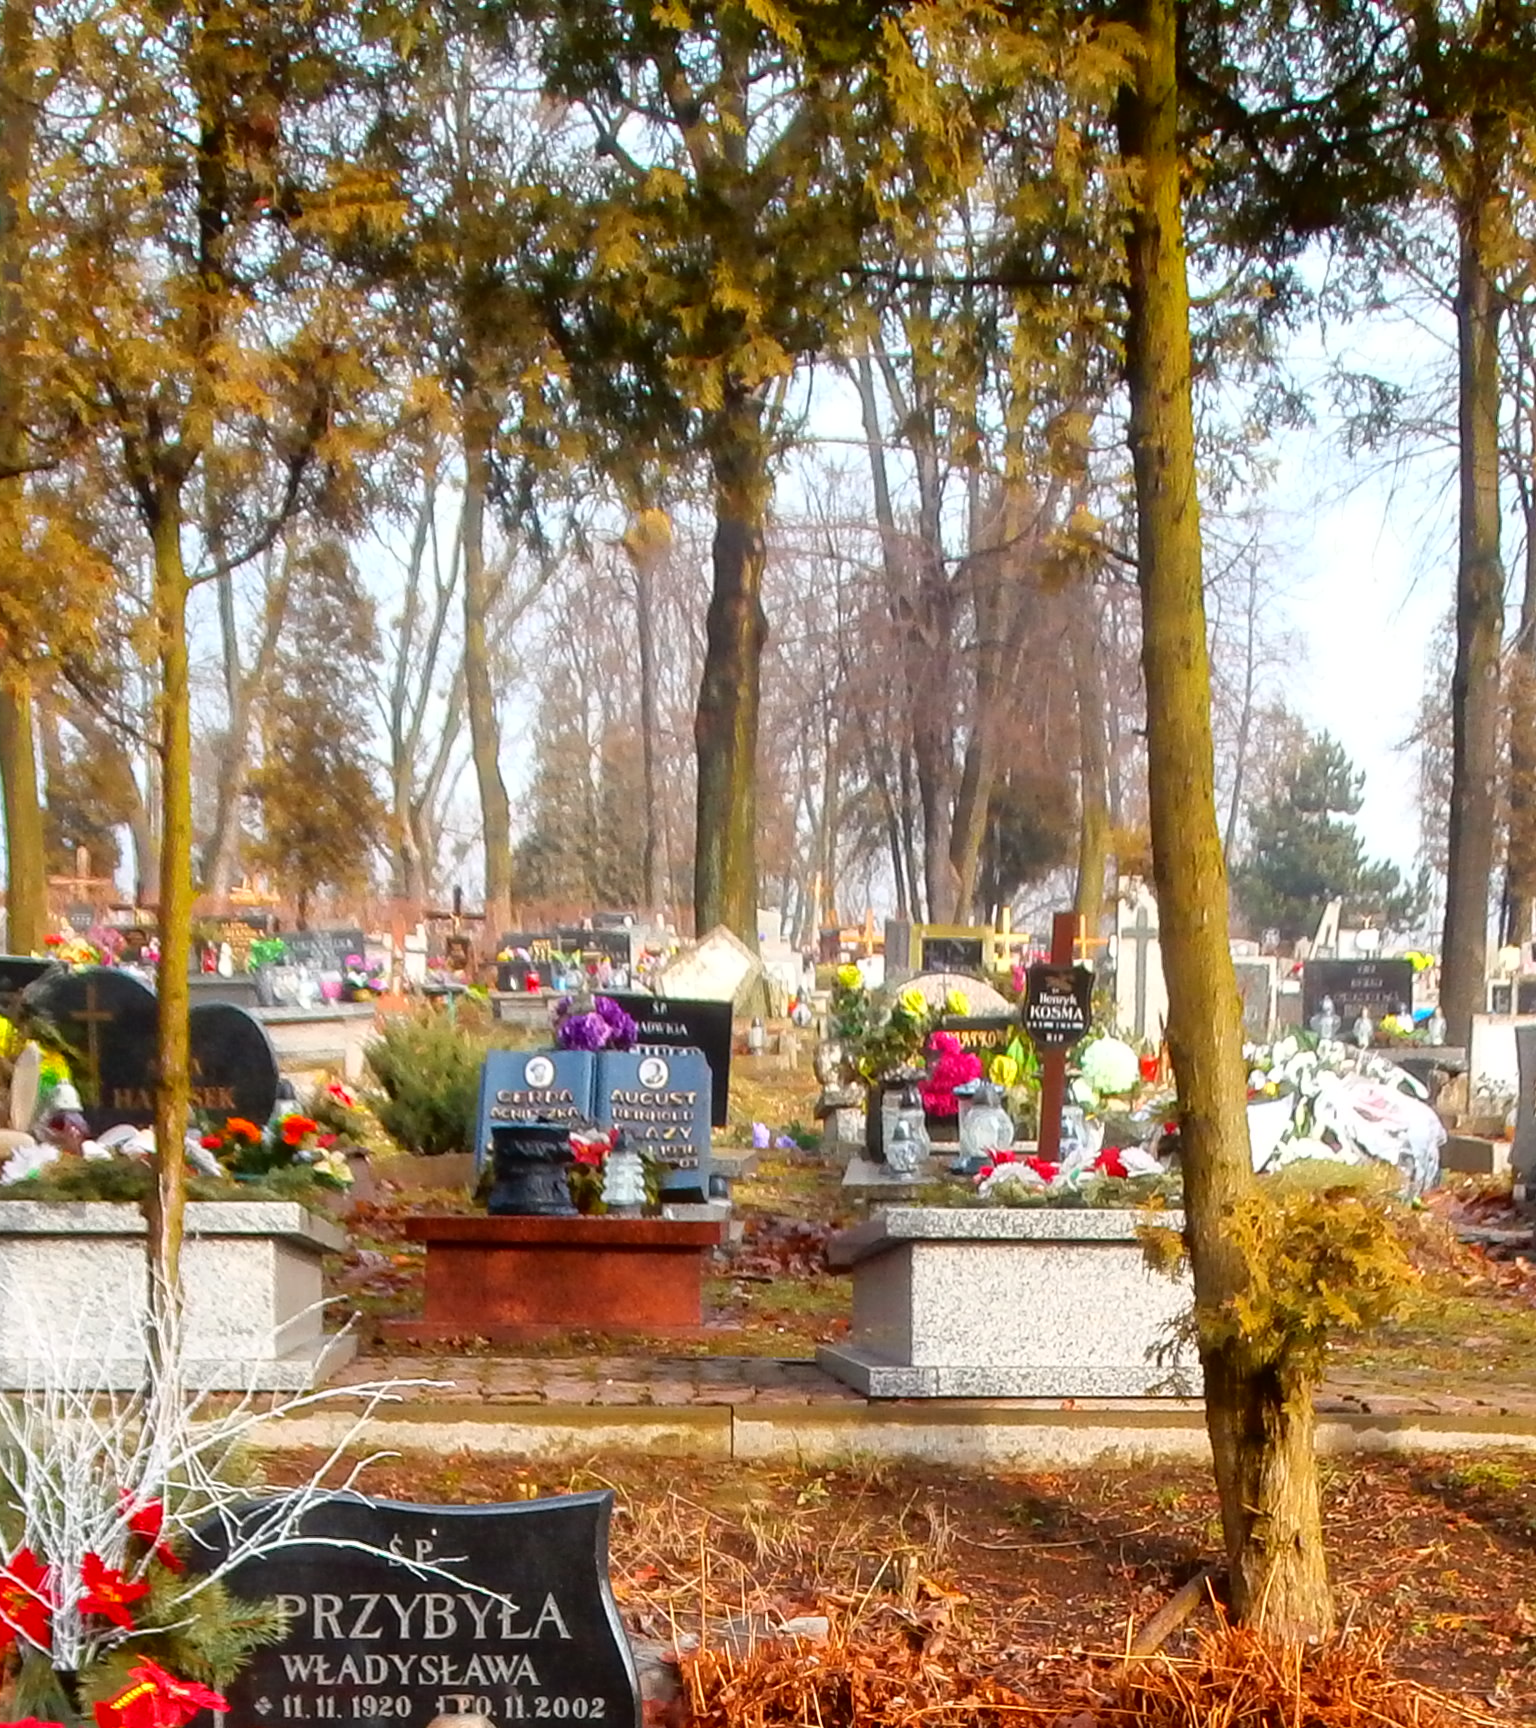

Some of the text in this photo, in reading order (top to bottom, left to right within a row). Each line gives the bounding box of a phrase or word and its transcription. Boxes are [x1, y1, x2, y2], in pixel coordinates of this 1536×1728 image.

[1039, 992, 1077, 1006] Henryk
[1030, 1005, 1083, 1021] KOSMA
[114, 1087, 237, 1109] HASEK
[275, 1592, 573, 1640] PRZYBYŁA
[279, 1653, 542, 1687] WŁADYSŁAWA
